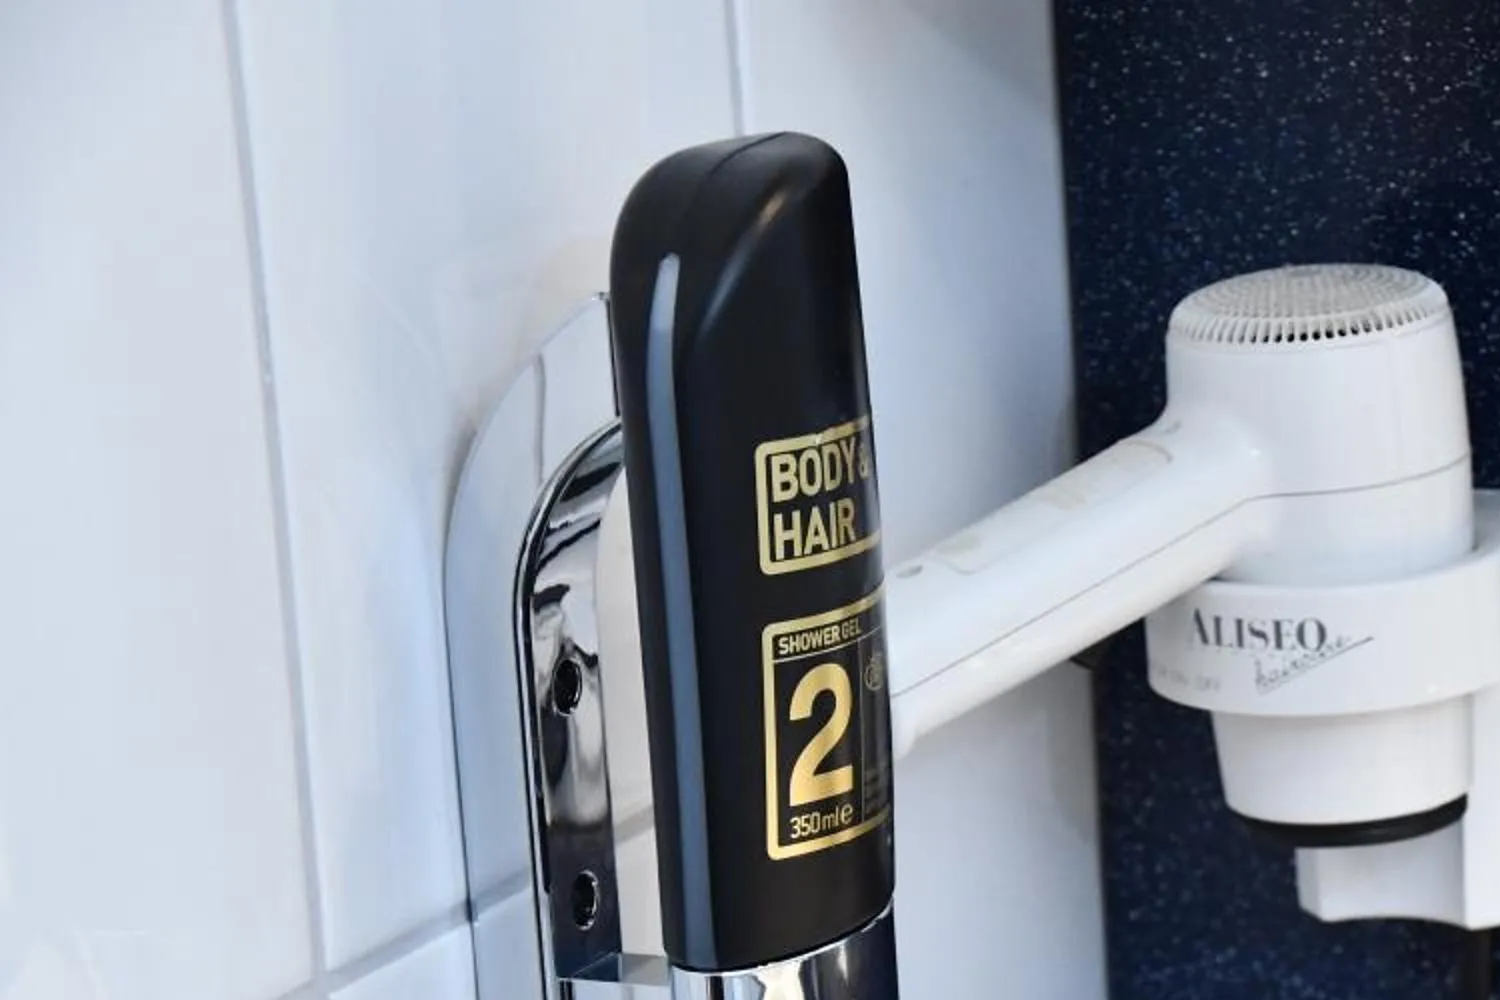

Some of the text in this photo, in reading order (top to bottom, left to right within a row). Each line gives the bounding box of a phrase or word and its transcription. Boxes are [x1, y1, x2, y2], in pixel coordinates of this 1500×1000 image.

[771, 437, 855, 503] BODY
[773, 498, 857, 560] HAIR
[778, 618, 862, 655] SHOWER GEL
[789, 662, 853, 807] 2
